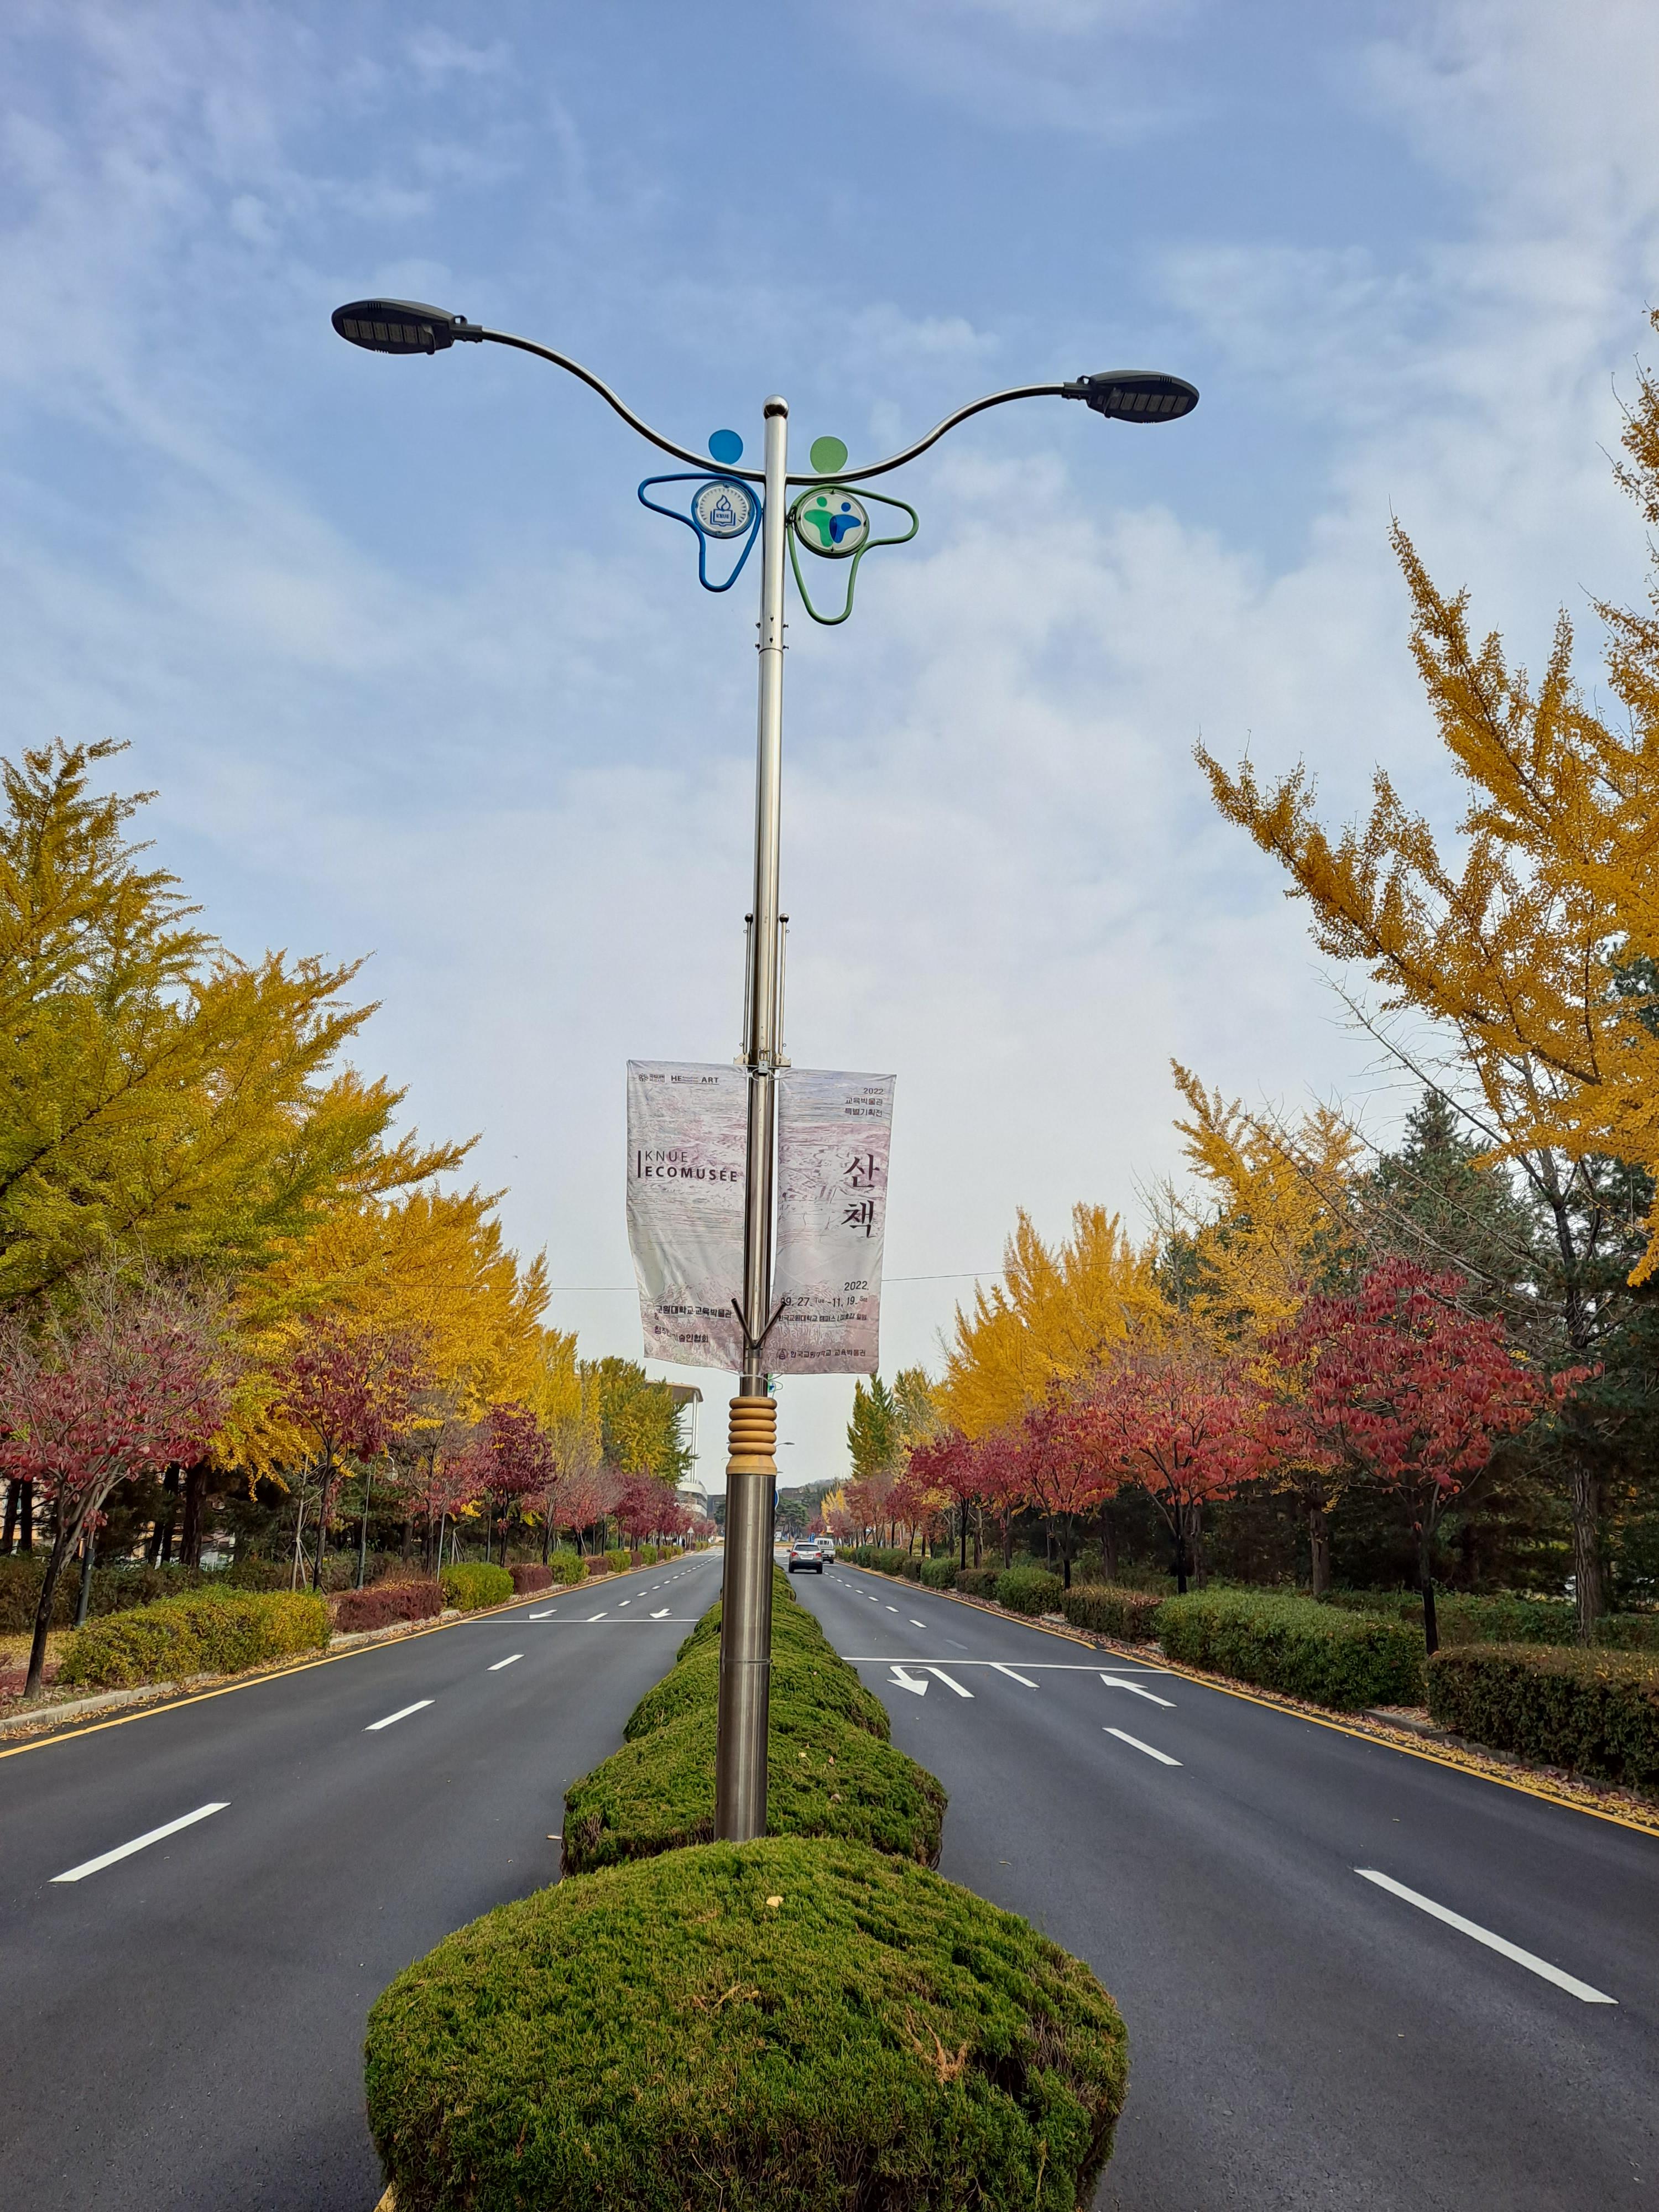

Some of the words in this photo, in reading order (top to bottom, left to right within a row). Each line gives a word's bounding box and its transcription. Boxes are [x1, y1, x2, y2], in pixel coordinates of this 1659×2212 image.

[845, 1097, 883, 1106] 교육박물관
[845, 1108, 883, 1117] 특별기획전
[645, 1150, 688, 1162] KNUE
[645, 1166, 738, 1182] ECOMUSÉE
[844, 1280, 869, 1291] 2022.
